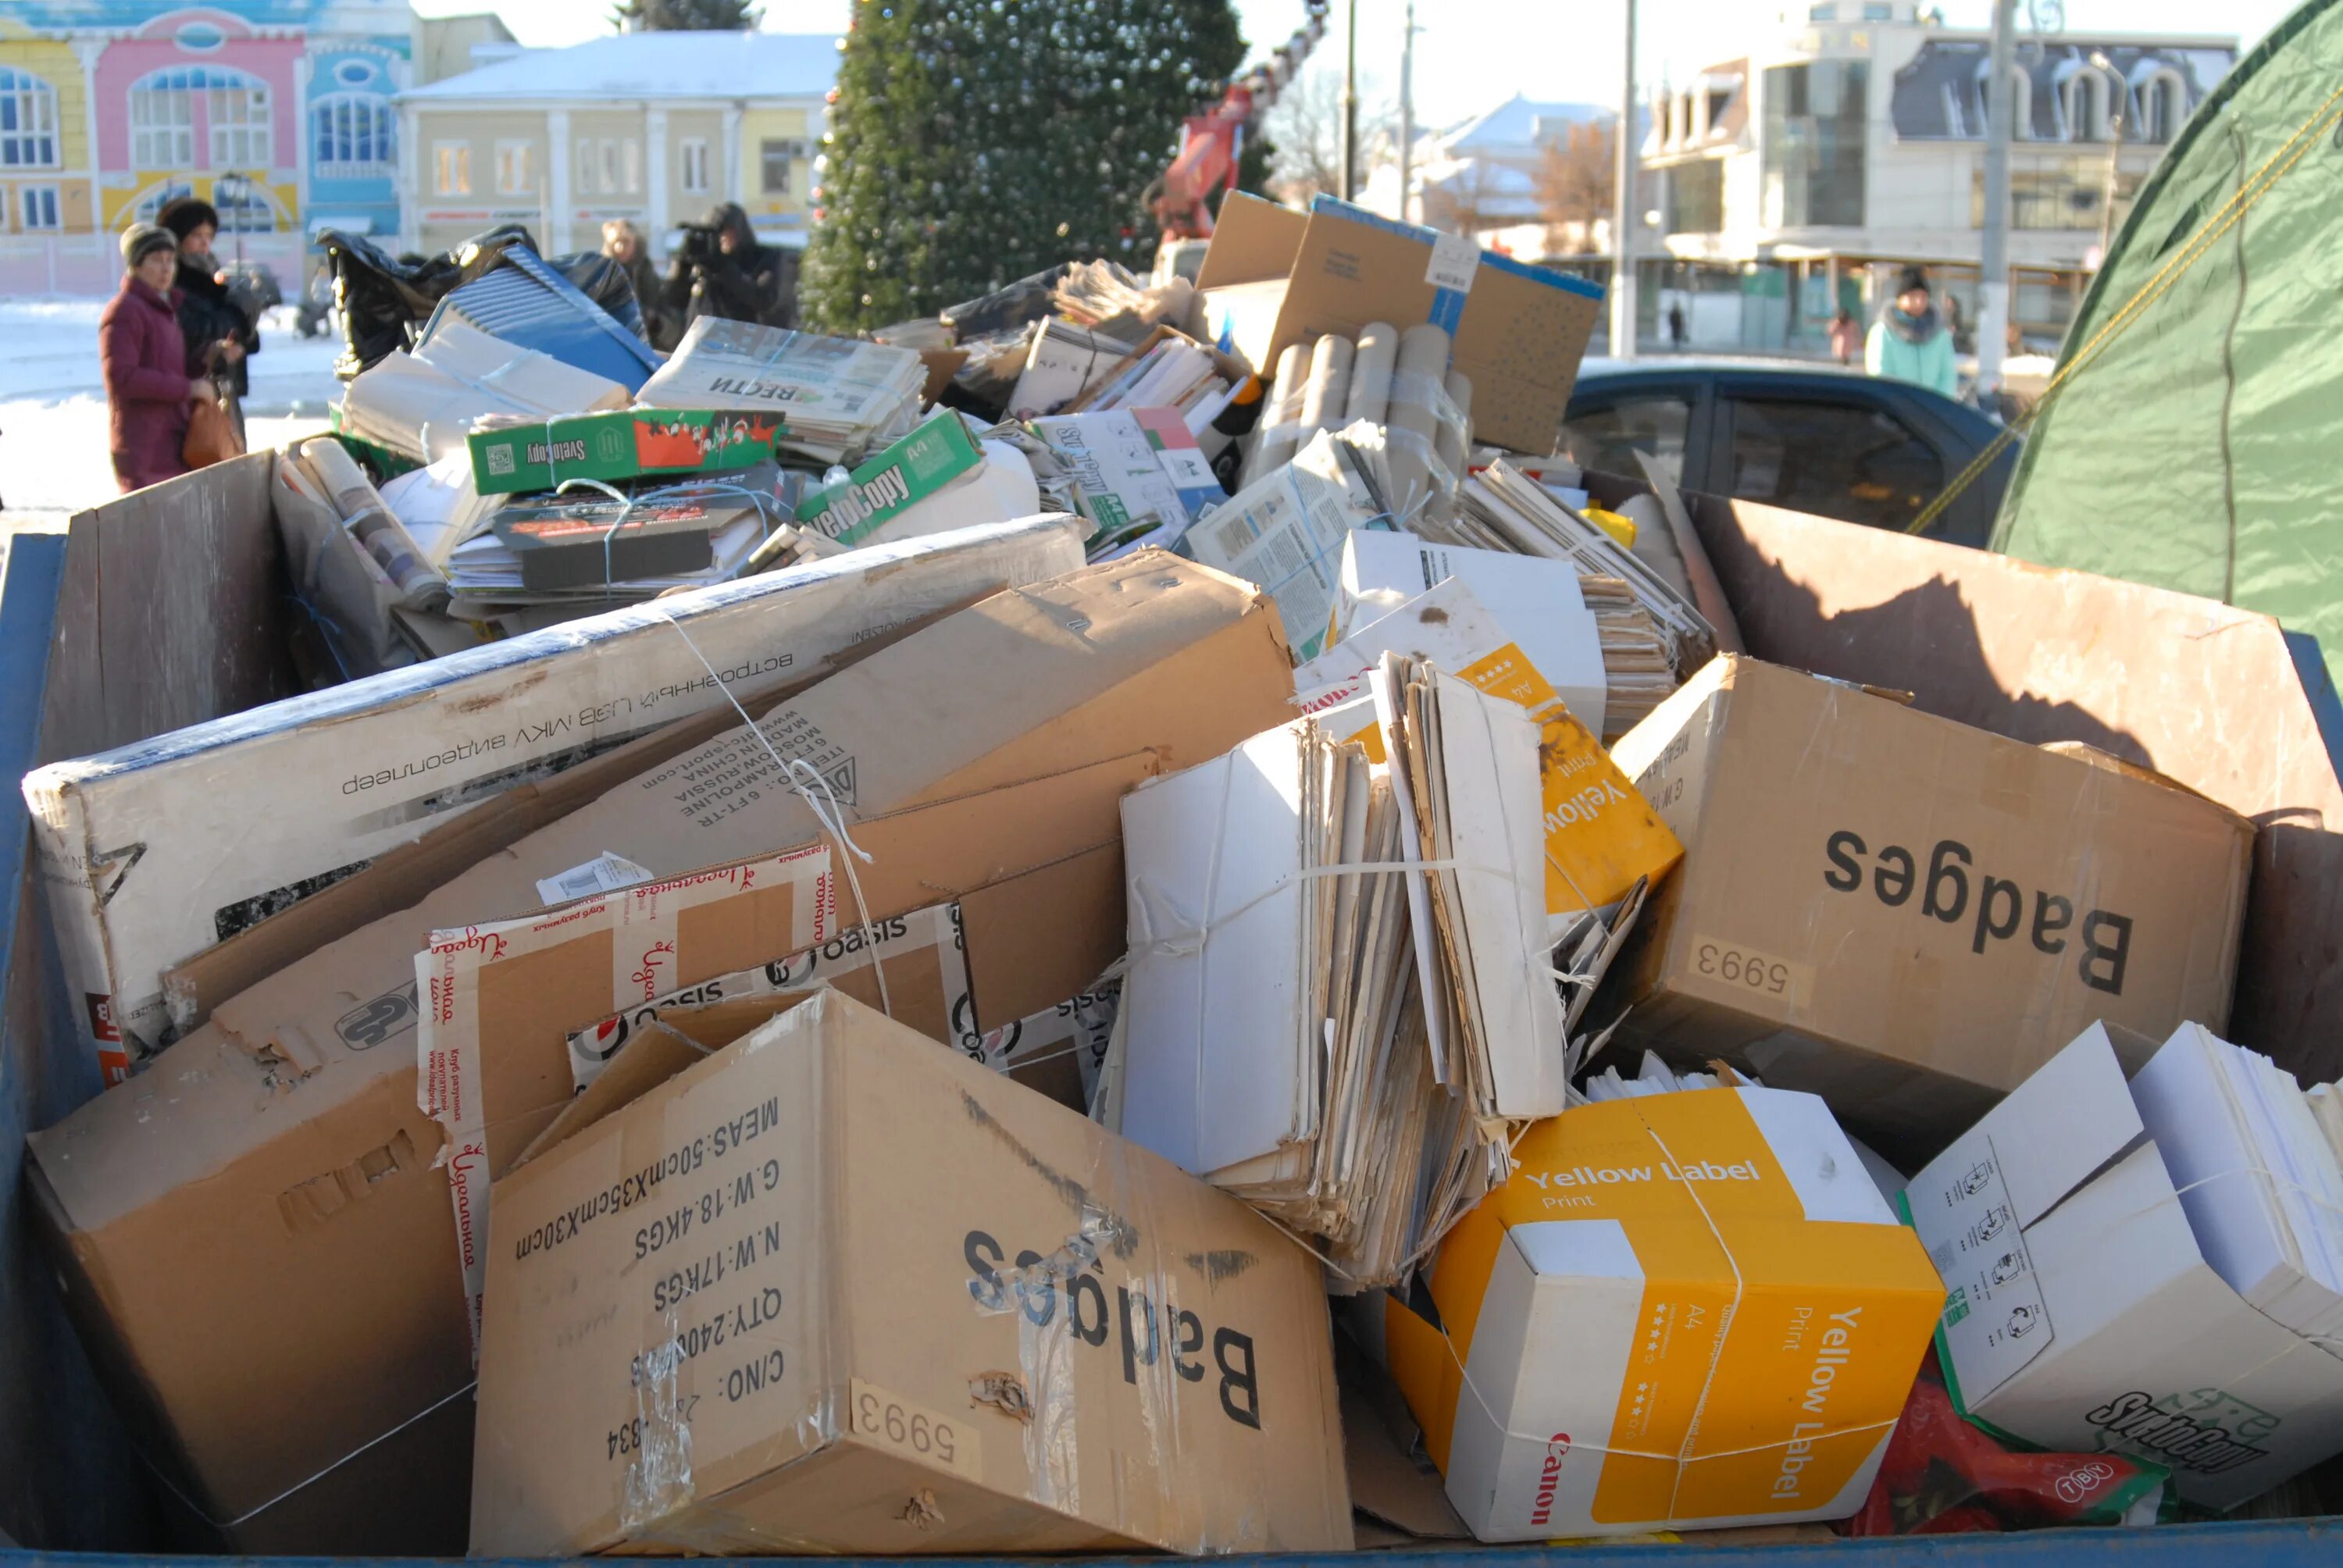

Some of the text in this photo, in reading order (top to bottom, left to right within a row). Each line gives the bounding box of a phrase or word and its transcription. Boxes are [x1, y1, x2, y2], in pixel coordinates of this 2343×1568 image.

[709, 377, 796, 401] ВЕСТИ
[527, 440, 585, 465] SvetoCopy
[804, 464, 910, 539] vetoCopy
[342, 732, 507, 794] видеоплеер
[514, 715, 572, 747] MKV
[682, 752, 738, 782] CHINA
[739, 743, 759, 755] IN
[1560, 752, 1598, 779] Print
[533, 904, 605, 932] Клуб разумных
[1824, 829, 2134, 996] Badges
[822, 916, 907, 960] oasis
[1697, 943, 1789, 995] 5993
[451, 1049, 462, 1122] Клуб разумных
[515, 1096, 779, 1261] MEAS:50cmX35cmX30cm
[1525, 1159, 1761, 1190] Yellow Label
[1542, 1193, 1597, 1210] Print
[963, 1229, 1262, 1431] Badges
[1684, 1303, 1706, 1330] A4
[1782, 1306, 1813, 1352] Print
[1770, 1305, 1863, 1499] Yellow Label
[860, 1390, 955, 1465] 5993
[1530, 1432, 1572, 1525] Canon
[2059, 1463, 2110, 1499] TBY
